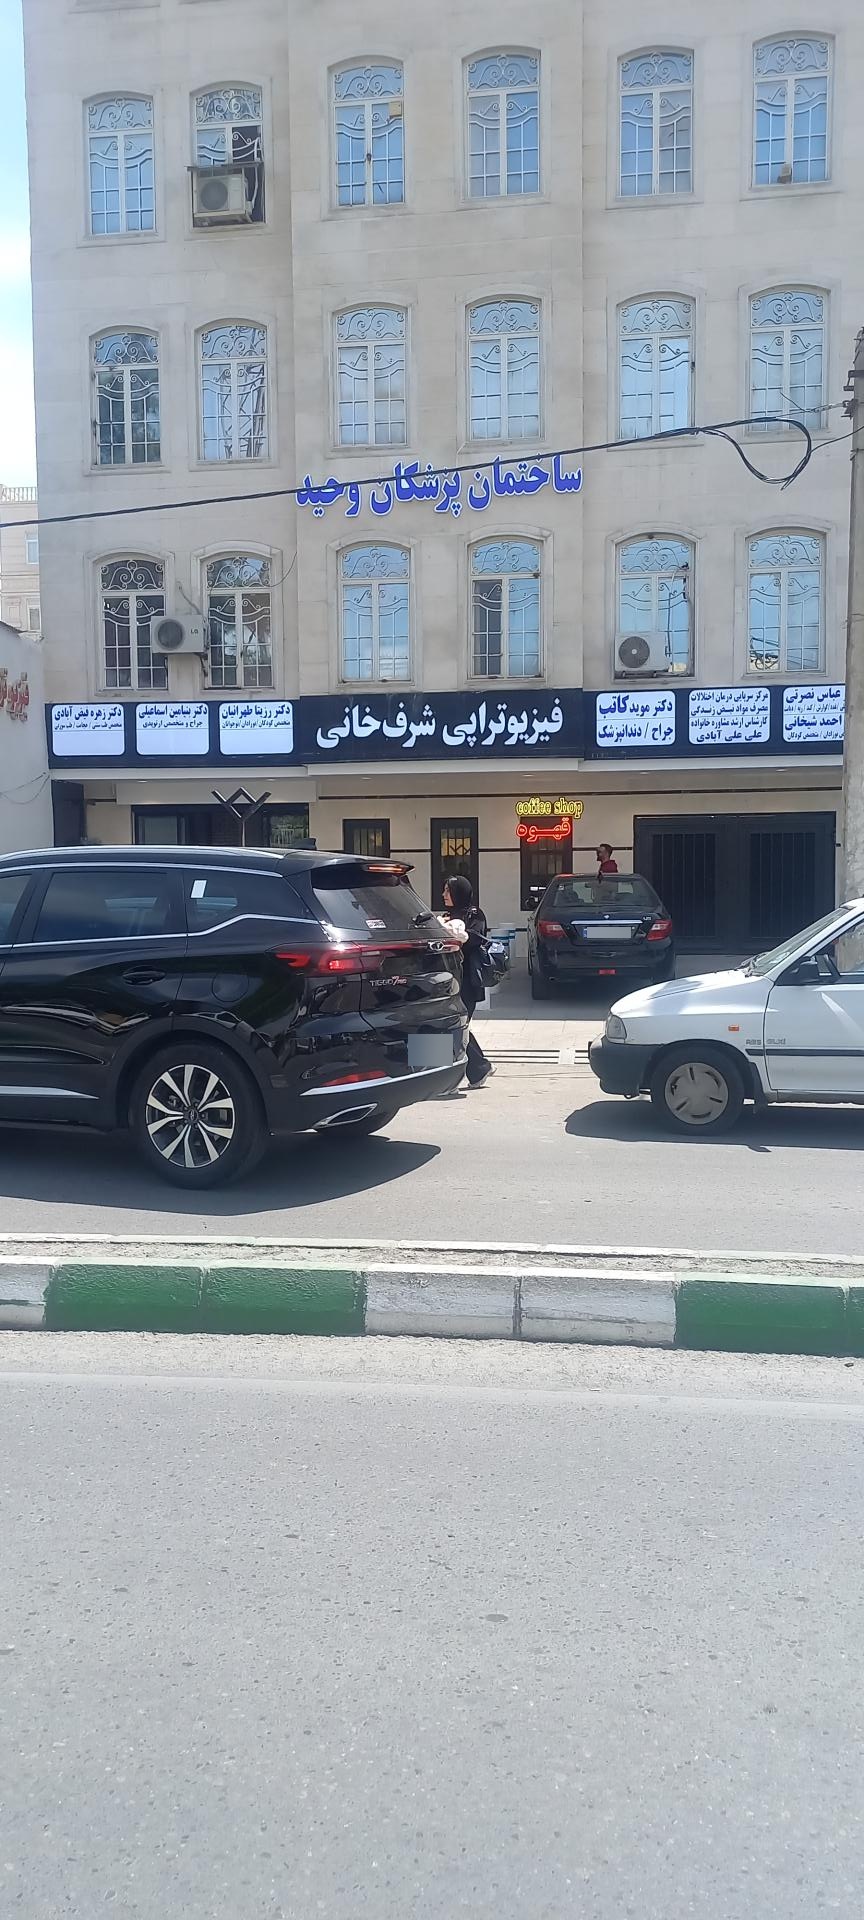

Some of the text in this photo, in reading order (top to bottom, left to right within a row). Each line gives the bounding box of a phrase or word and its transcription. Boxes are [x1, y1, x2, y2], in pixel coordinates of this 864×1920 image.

[296, 454, 583, 517] ساختمان پزشکان وحید
[715, 691, 732, 703] درمان
[755, 690, 768, 701] مرکز
[786, 687, 841, 703] عباس نصرتی
[55, 706, 122, 721] دکتر زهره فیض آبادی
[138, 704, 208, 719] دکتر بنیامین اسماعیلی
[222, 704, 291, 719] دکتر رزیتا طهرانیان
[599, 694, 673, 719] دکتر موید کاتب
[735, 704, 748, 715] مواد
[750, 703, 768, 714] مصرف
[189, 719, 203, 728] جراح
[442, 698, 564, 747] فیزیوتراپی
[691, 718, 710, 729] خانواده
[731, 717, 744, 728] ارشد
[745, 716, 768, 728] کارشناس
[785, 714, 842, 731] احمد شیخانی
[652, 722, 674, 741] جراح
[696, 729, 762, 742] علی علی آبادی
[516, 797, 583, 819] coffee shop
[516, 817, 571, 842] قهوه
